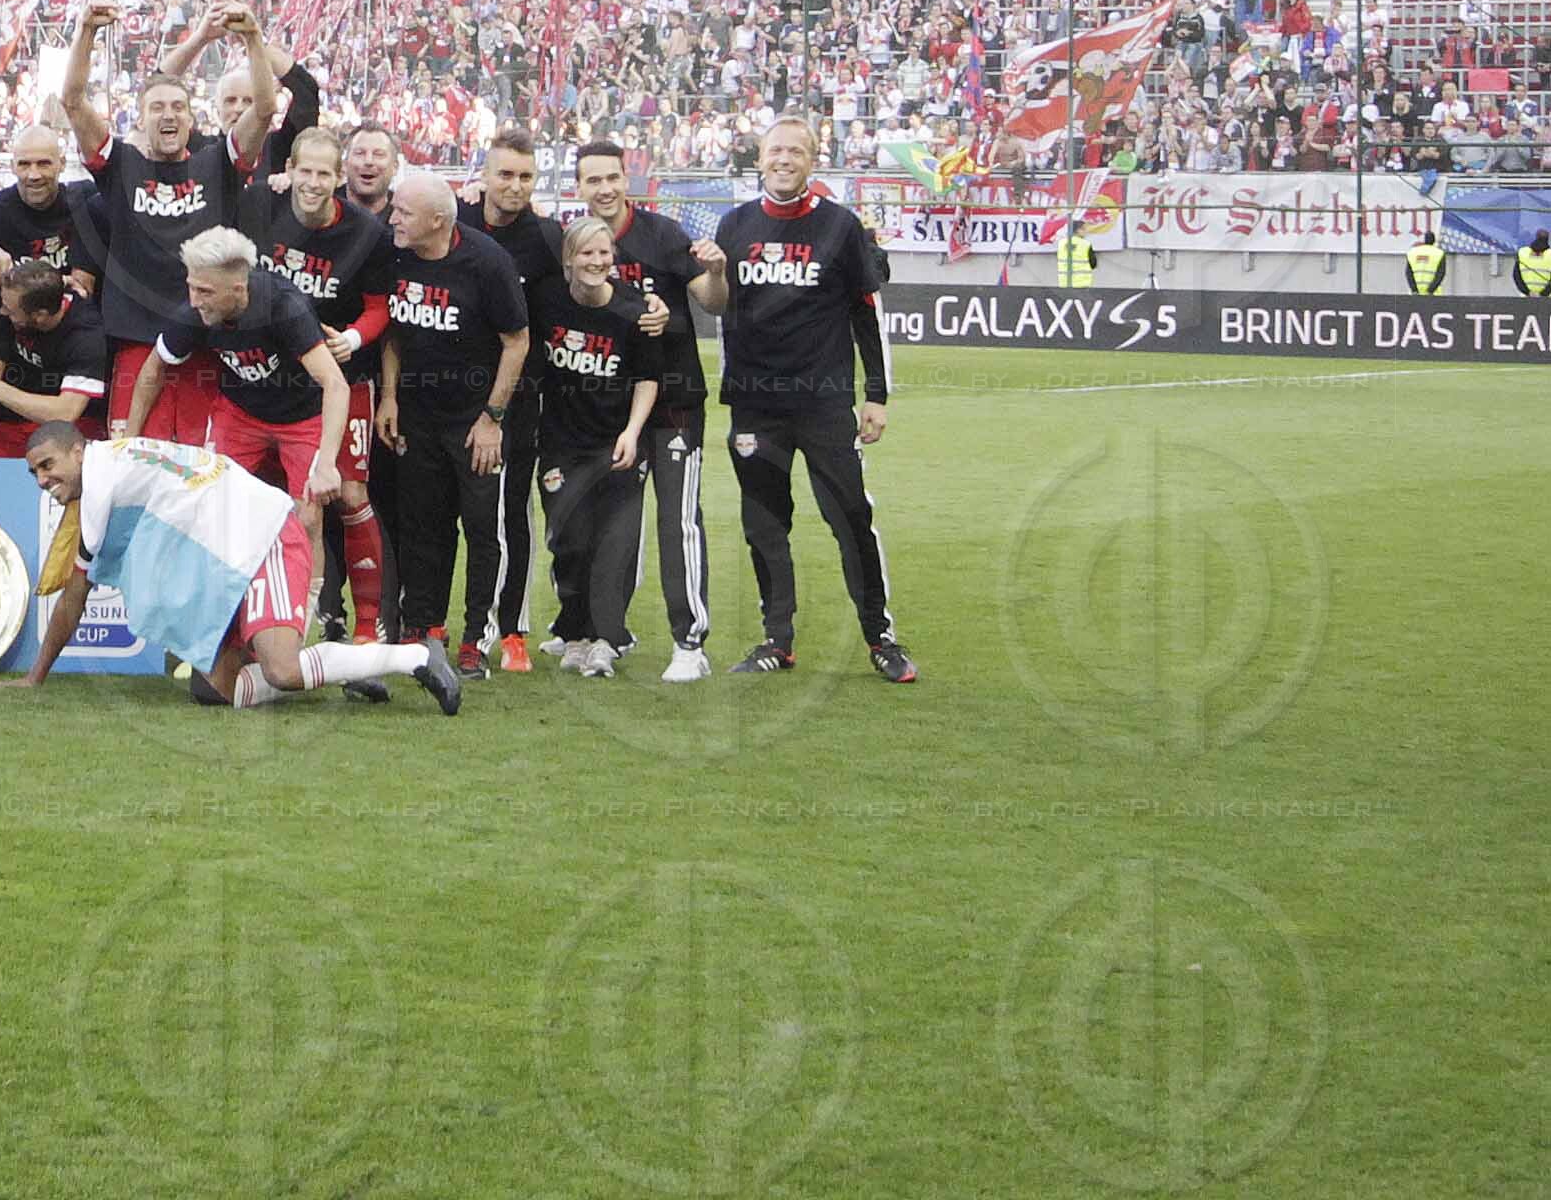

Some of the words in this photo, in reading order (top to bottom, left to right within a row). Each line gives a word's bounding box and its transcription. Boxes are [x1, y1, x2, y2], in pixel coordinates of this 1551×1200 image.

[132, 184, 207, 217] DOUBLE
[1137, 185, 1209, 235] FC
[737, 260, 822, 287] DOUBLE
[388, 294, 460, 332] DOUBLE
[934, 295, 1103, 340] GALAXY
[1219, 307, 1363, 348] BRINGT
[1374, 311, 1455, 350] DAS
[1464, 313, 1551, 353] TEA
[544, 340, 621, 378] DOUBLE
[349, 418, 368, 457] 31
[75, 628, 109, 643] CUP
